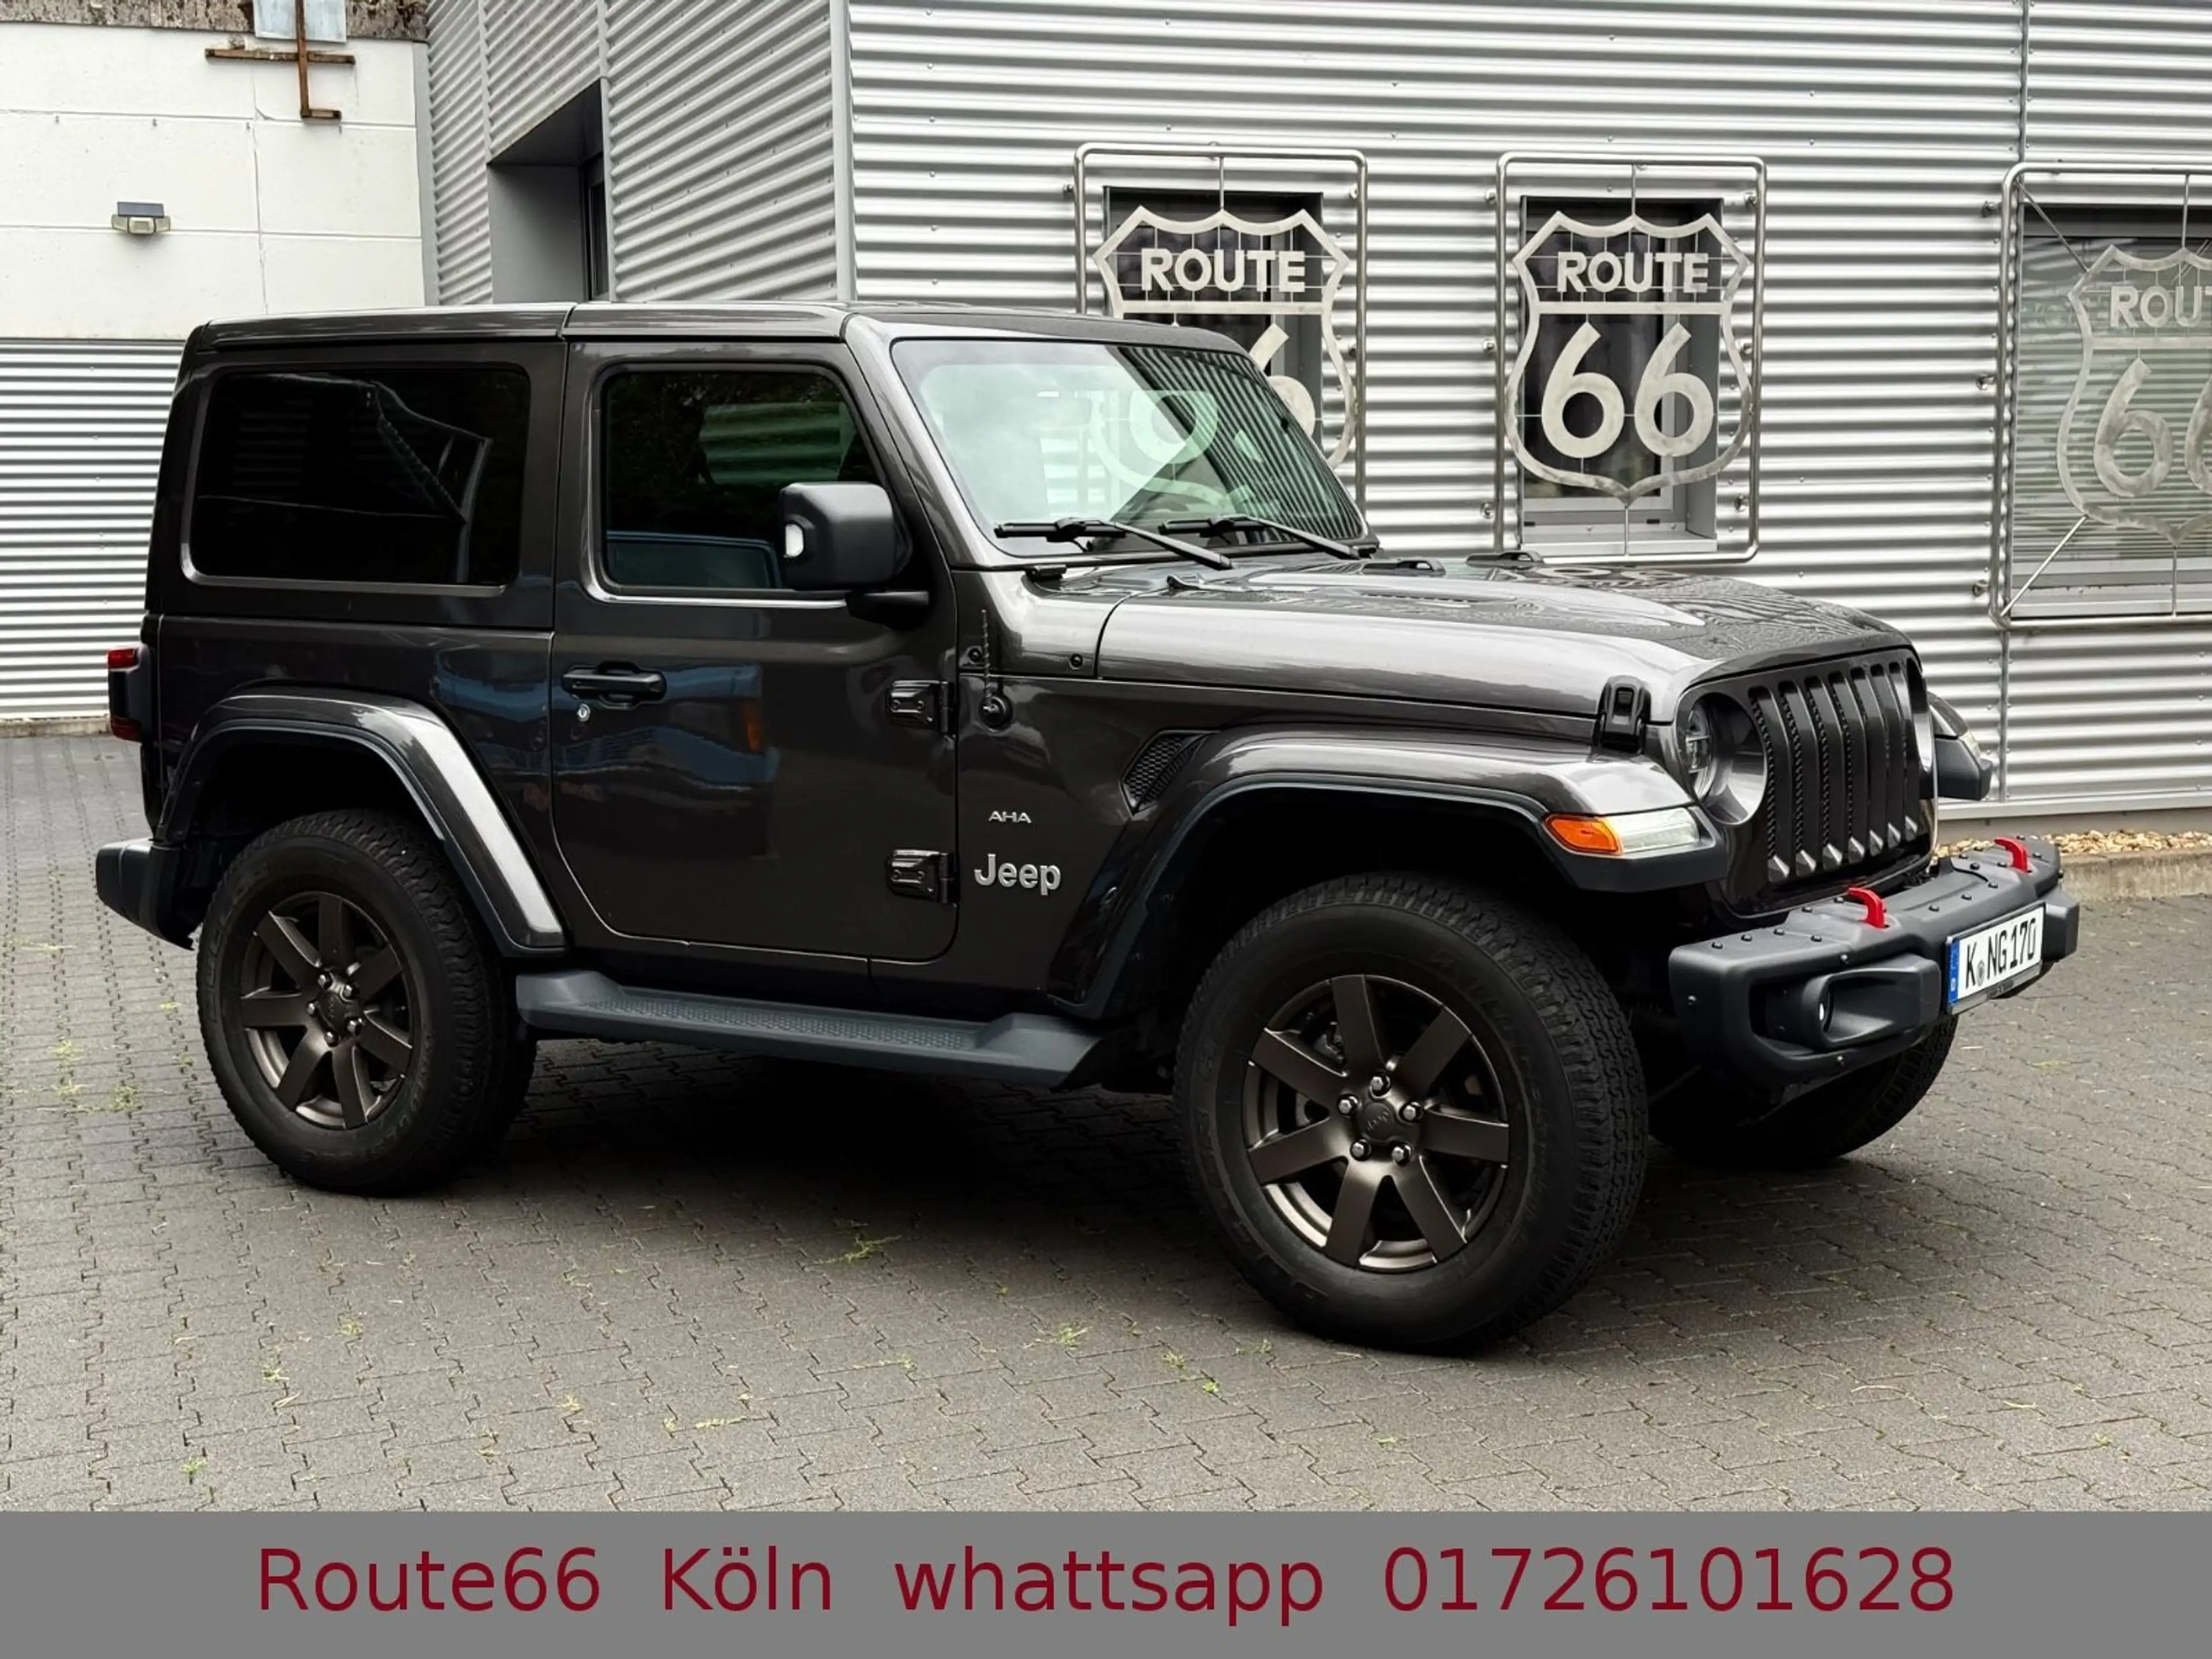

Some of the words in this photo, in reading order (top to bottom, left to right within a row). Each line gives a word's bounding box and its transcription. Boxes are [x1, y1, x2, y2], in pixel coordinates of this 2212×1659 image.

[1141, 249, 1305, 292] ROUTE
[1557, 252, 1709, 293] ROUTE
[2111, 286, 2212, 328] ROU
[1541, 322, 1714, 458] 66
[988, 810, 1032, 824] AHA
[974, 853, 1061, 896] Jeep
